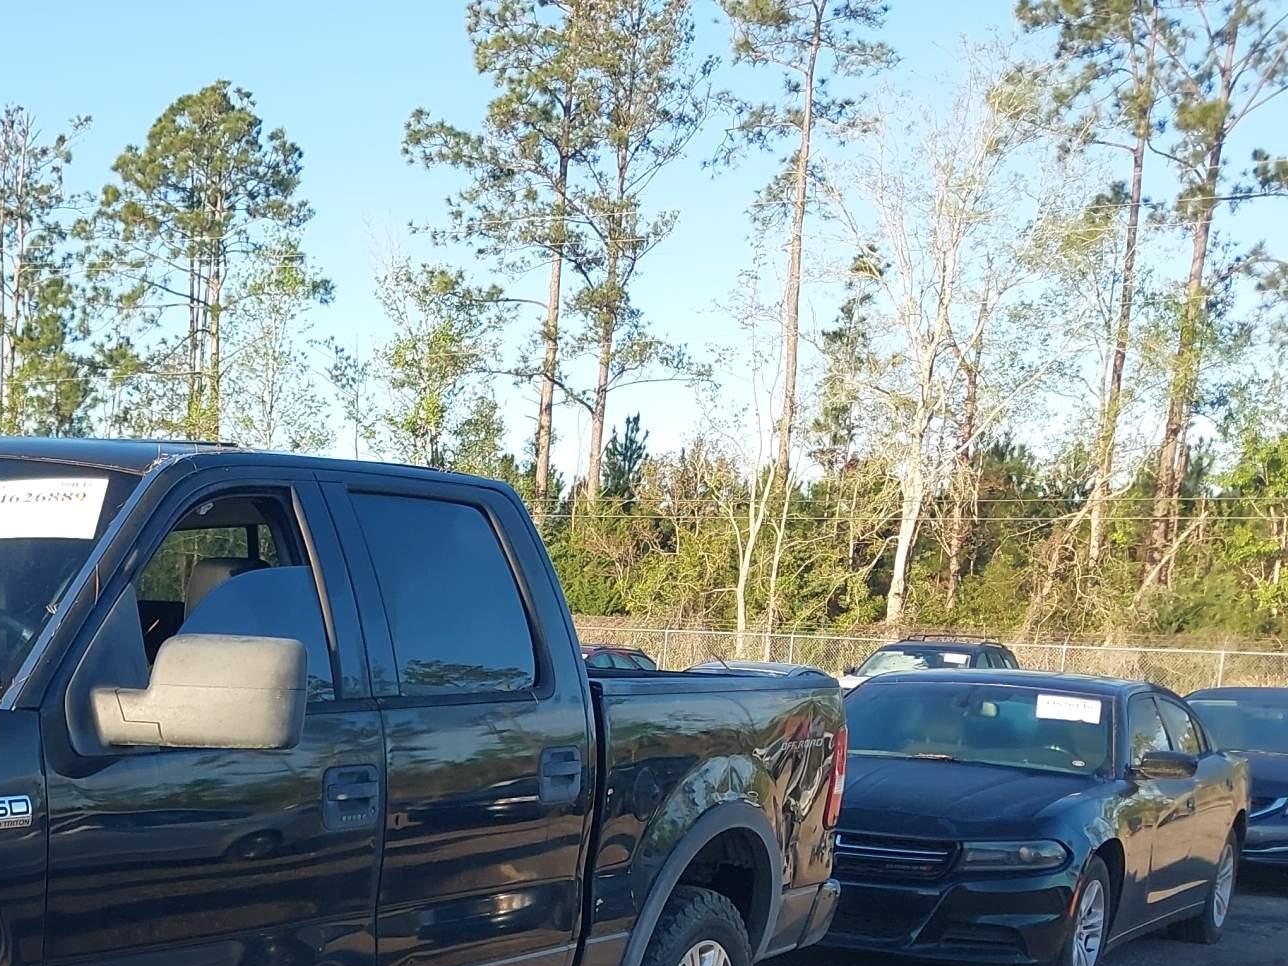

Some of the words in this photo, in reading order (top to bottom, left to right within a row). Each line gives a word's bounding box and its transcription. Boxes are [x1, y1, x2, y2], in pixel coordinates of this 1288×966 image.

[781, 740, 798, 751] OFF
[798, 738, 823, 749] ROAD
[4, 819, 30, 827] TRITON
